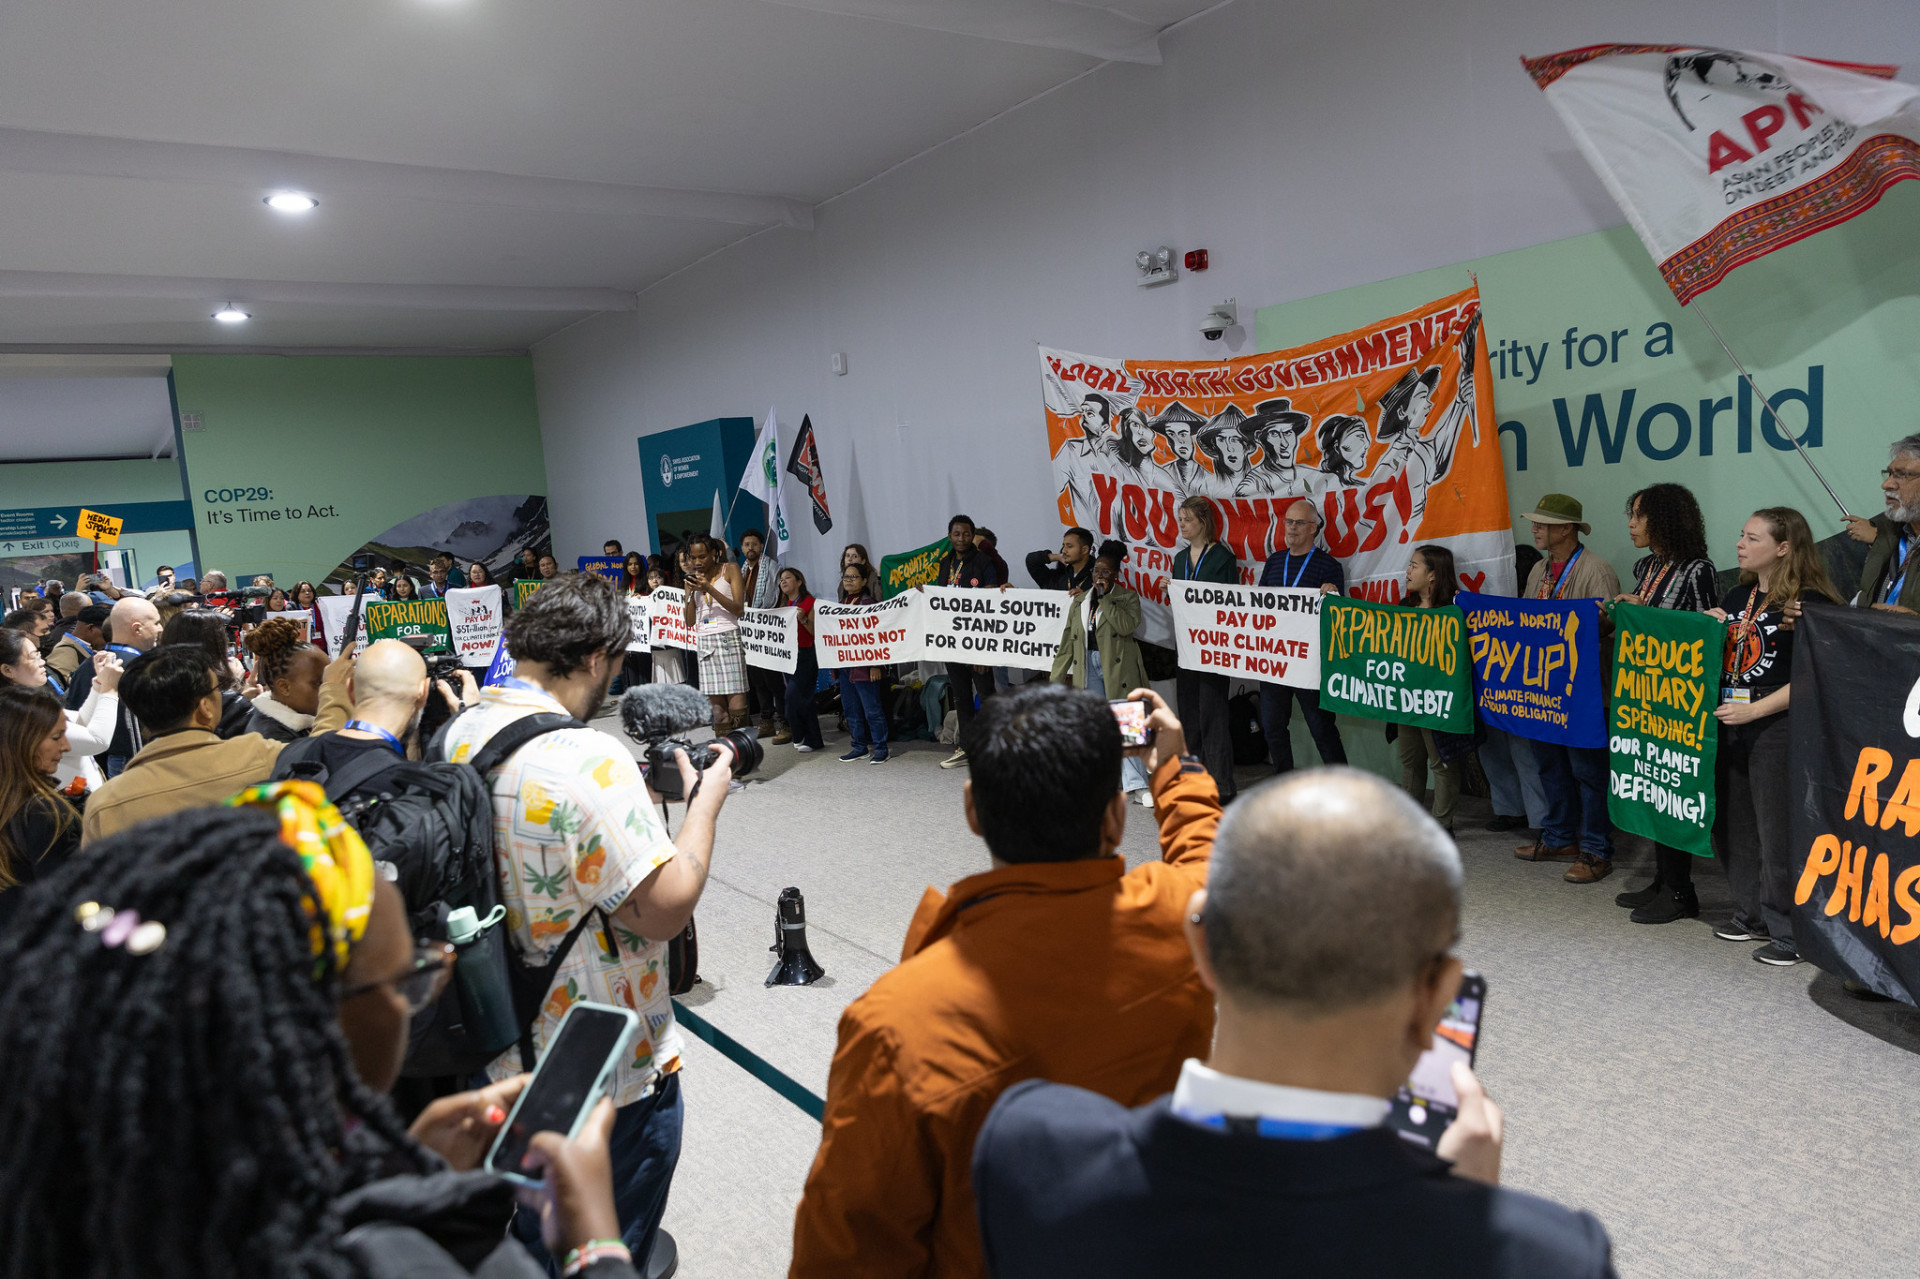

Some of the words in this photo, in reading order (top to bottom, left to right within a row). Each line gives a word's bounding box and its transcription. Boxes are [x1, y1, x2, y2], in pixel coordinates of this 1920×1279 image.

[1724, 184, 1753, 206] ON
[1753, 165, 1797, 193] DEBT
[1562, 326, 1629, 370] for
[1643, 321, 1674, 358] a
[1137, 368, 1234, 398] NORTH
[1552, 364, 1824, 468] World
[204, 486, 274, 503] COP29:
[87, 513, 111, 526] MEDIA
[207, 509, 234, 525] It's
[236, 508, 281, 523] Time
[285, 506, 303, 520] to
[307, 504, 340, 519] Act.
[1091, 472, 1179, 548] YOU
[1323, 465, 1412, 558] US!
[85, 521, 118, 536] SPOKES
[22, 541, 45, 550] Exit
[929, 596, 996, 614] GLOBAL
[1000, 600, 1061, 619] SOUTH:
[1184, 586, 1246, 608] GLOBAL
[367, 601, 447, 635] REPARATIONS
[480, 610, 492, 622] UP!
[667, 604, 681, 616] PAY
[757, 613, 787, 628] SOUTH:
[819, 605, 861, 615] GLOBAL
[1216, 610, 1249, 629] PAY
[1252, 613, 1277, 631] UP
[1466, 609, 1515, 633] GLOBAL
[397, 625, 421, 636] FOR
[653, 616, 674, 628] FOR
[839, 616, 860, 630] PAY
[862, 615, 880, 630] UP
[952, 616, 1008, 634] STAND
[1013, 620, 1036, 636] UP
[461, 640, 495, 651] NOW!
[658, 628, 697, 646] FINANCE
[754, 629, 766, 640] UP
[767, 631, 785, 644] FOR
[822, 632, 876, 647] TRILLIONS
[878, 629, 907, 644] NOT
[925, 633, 957, 650] FOR
[961, 636, 999, 652] OUR
[1188, 628, 1230, 648] YOUR
[1233, 633, 1310, 660] CLIMATE
[1327, 604, 1461, 677] REPARATIONS
[750, 643, 762, 653] NOT
[764, 645, 792, 660] BILLIONS
[837, 647, 891, 662] BILLIONS
[1468, 631, 1522, 684] PAY
[1617, 629, 1705, 679] REDUCE
[1200, 649, 1240, 669] DEBT
[1245, 655, 1289, 679] NOW
[1366, 659, 1406, 683] FOR
[1742, 650, 1778, 683] FUEL
[1326, 672, 1399, 712] CLIMATE
[1400, 689, 1455, 720] DEBT!
[1483, 687, 1523, 703] CLIMATE
[1524, 691, 1562, 710] FINANCE
[1614, 667, 1705, 718] MILITARY
[1615, 704, 1708, 752] SPENDING!
[1609, 735, 1642, 757] OUR
[1646, 742, 1701, 778] PLANET
[1634, 758, 1682, 788] NEEDS
[1609, 769, 1706, 829] DEFENDING!
